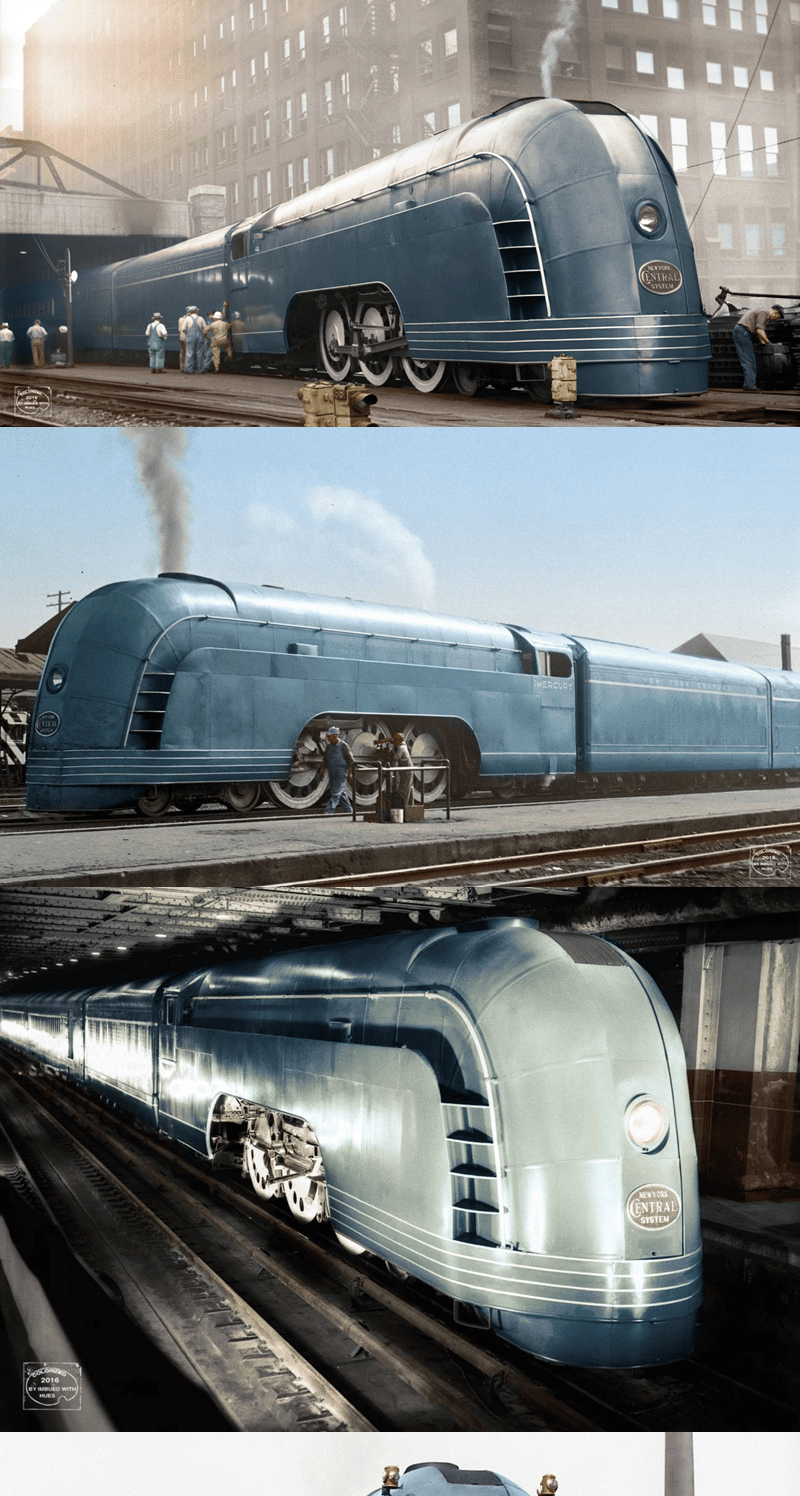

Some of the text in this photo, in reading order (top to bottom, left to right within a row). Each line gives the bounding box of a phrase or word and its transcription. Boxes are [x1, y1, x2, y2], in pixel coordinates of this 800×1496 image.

[641, 270, 680, 285] CENTRAL
[534, 680, 573, 690] MERCURY
[638, 1190, 669, 1199] NEW YORK
[629, 1198, 679, 1218] CENTRAL
[640, 1215, 670, 1224] SYSTEM
